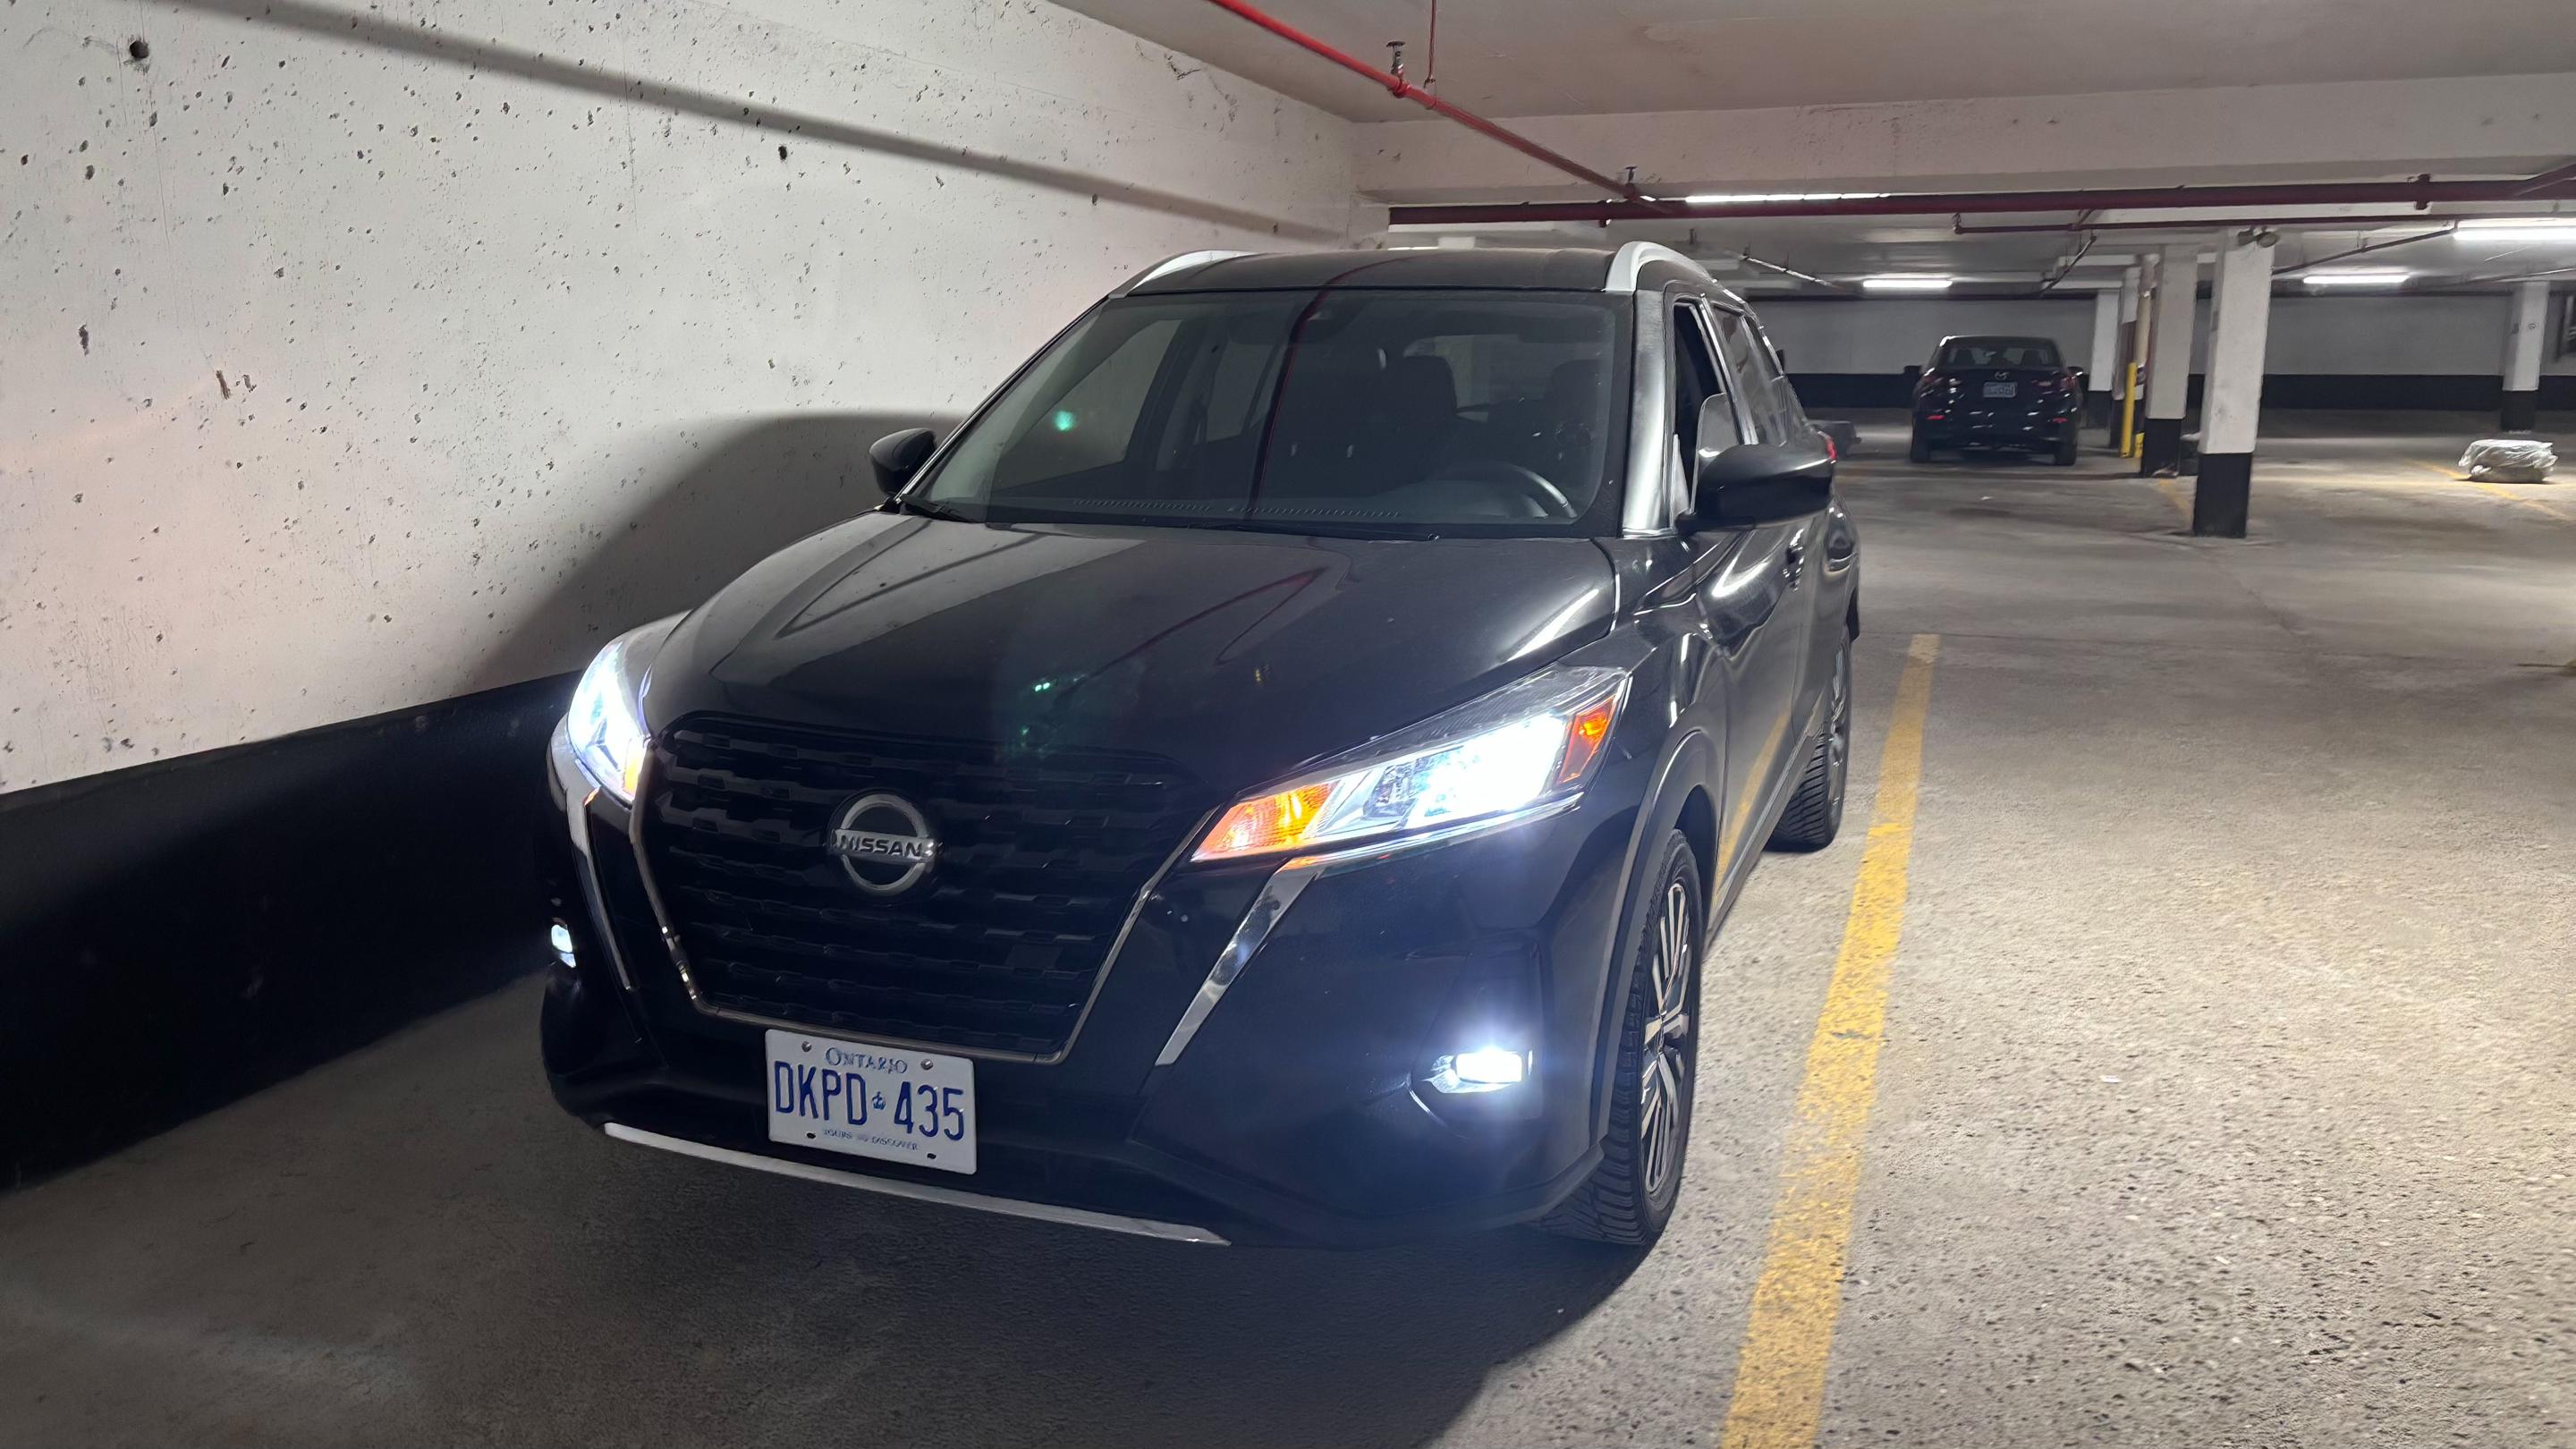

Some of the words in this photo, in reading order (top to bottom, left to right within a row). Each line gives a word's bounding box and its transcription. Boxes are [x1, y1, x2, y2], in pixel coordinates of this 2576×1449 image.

[839, 835, 923, 857] NISSAN
[826, 1047, 908, 1073] ONTARIO
[775, 1061, 868, 1125] DKPD
[894, 1081, 964, 1140] 435
